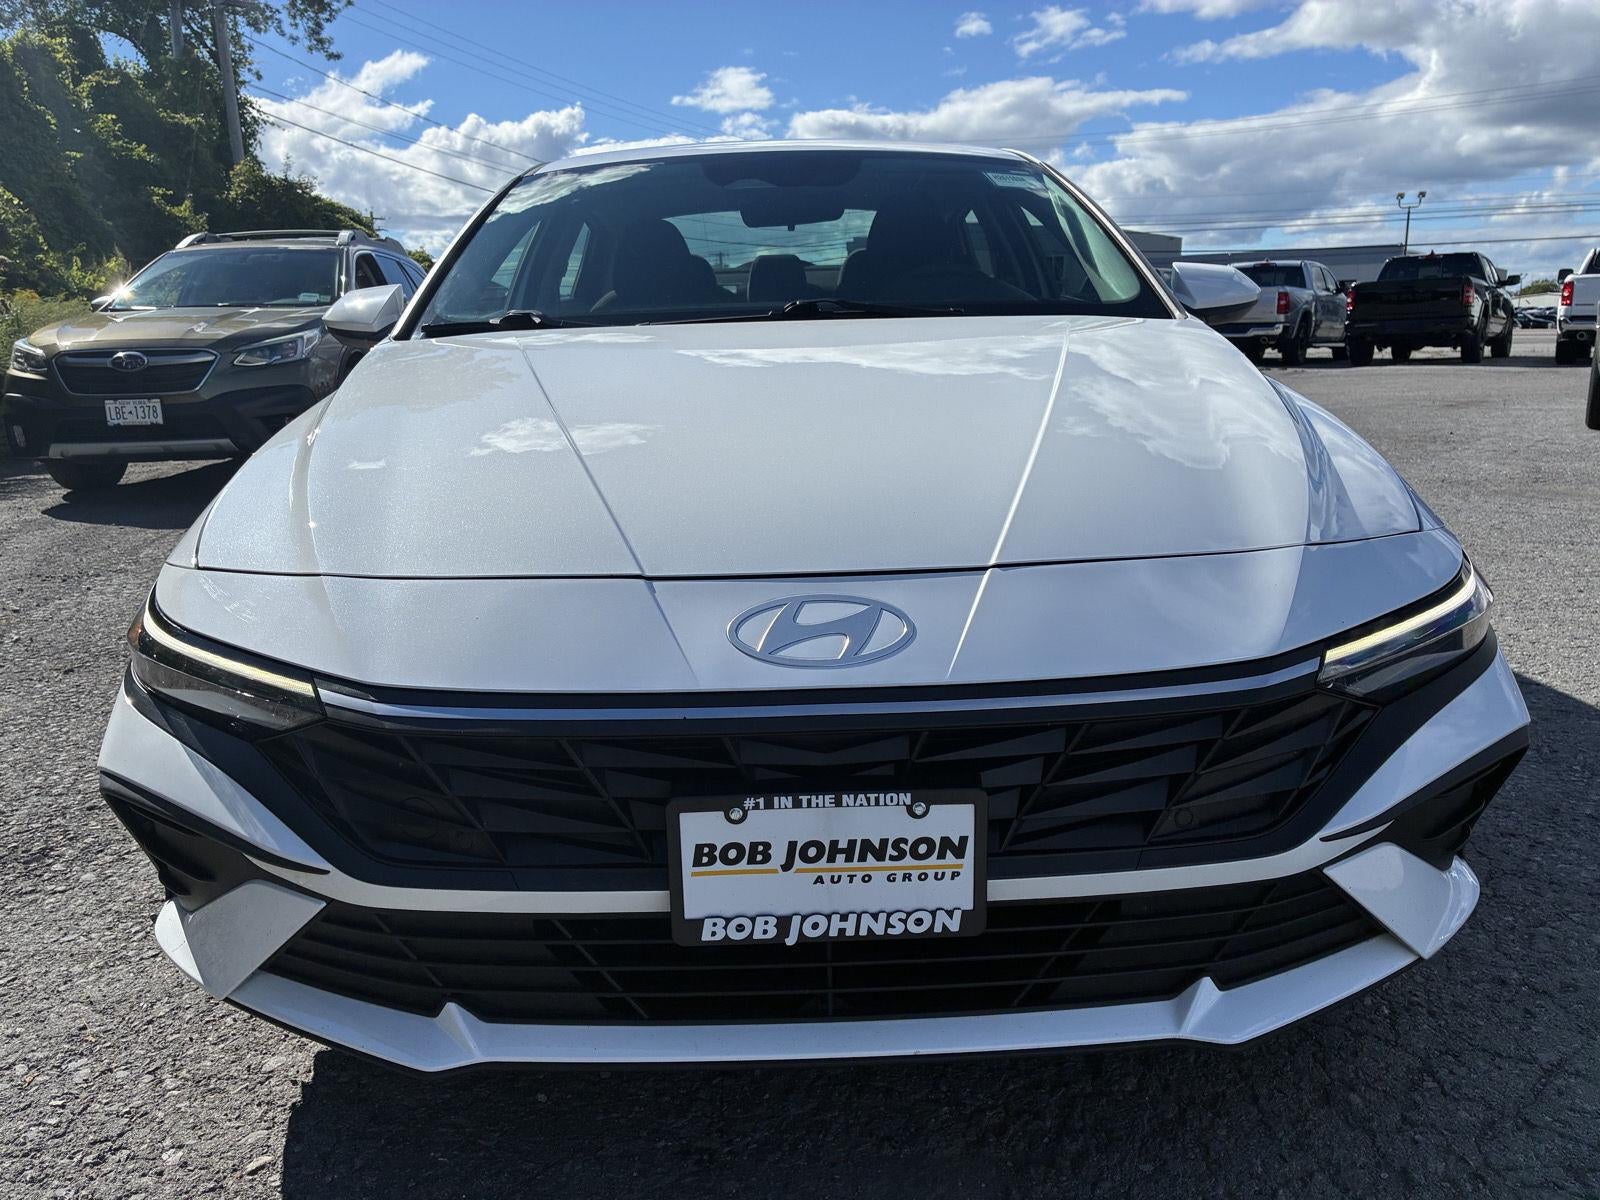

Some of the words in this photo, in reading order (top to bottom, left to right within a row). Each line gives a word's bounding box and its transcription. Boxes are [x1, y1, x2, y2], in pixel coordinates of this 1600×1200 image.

[743, 797, 765, 810] #1
[773, 796, 793, 809] IN
[799, 794, 835, 808] THE
[841, 792, 912, 807] NATION
[692, 841, 772, 868] BOB
[780, 835, 969, 872] JOHNSON
[813, 874, 873, 885] AUTO
[886, 870, 961, 883] GROUP
[701, 915, 778, 941] BOB
[785, 909, 962, 945] JOHNSON
